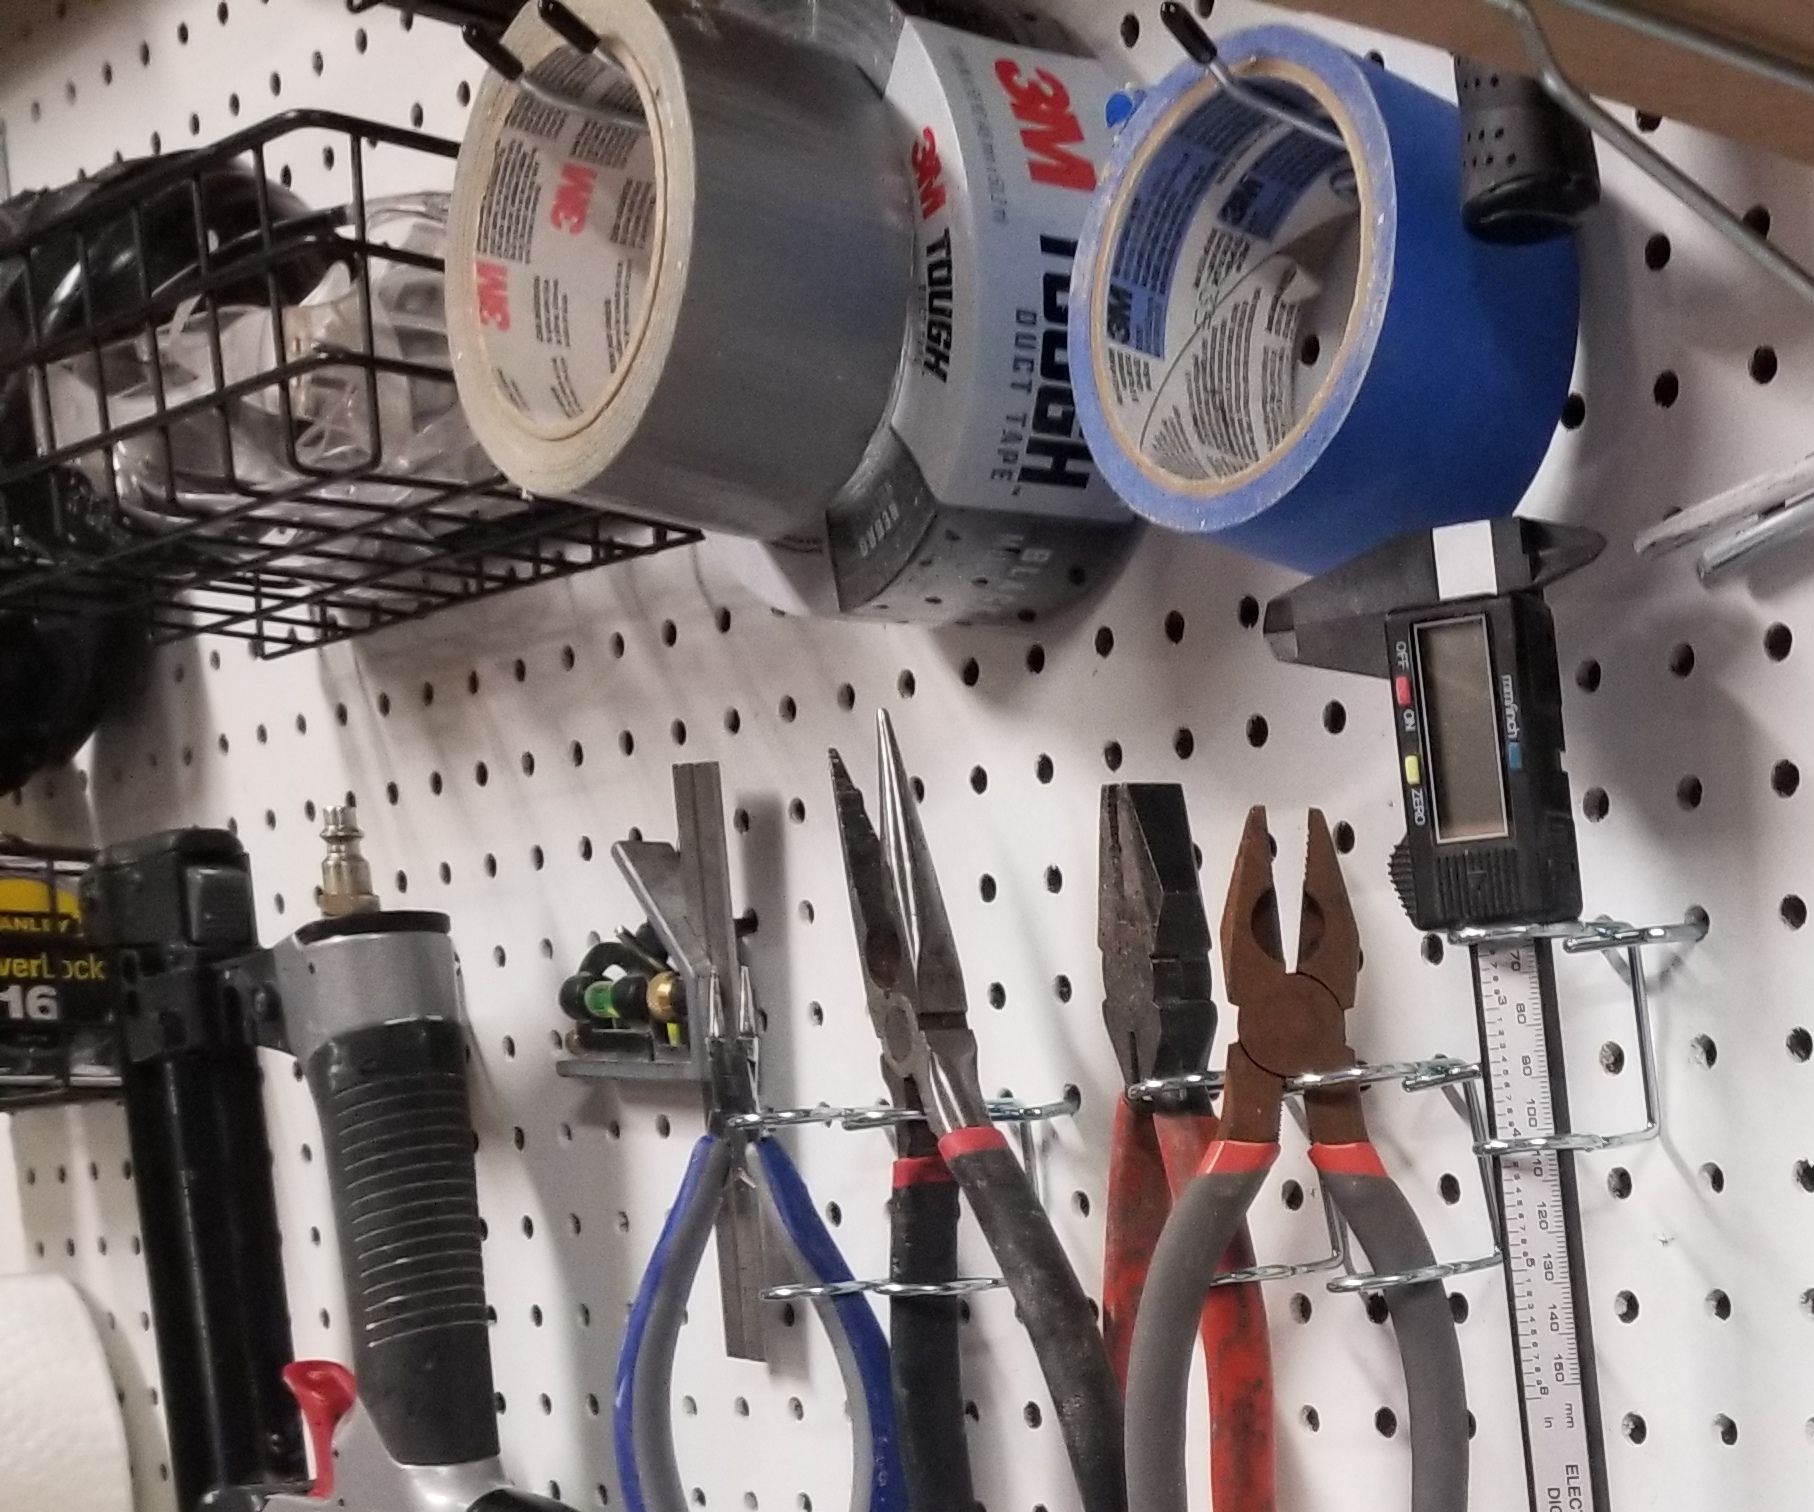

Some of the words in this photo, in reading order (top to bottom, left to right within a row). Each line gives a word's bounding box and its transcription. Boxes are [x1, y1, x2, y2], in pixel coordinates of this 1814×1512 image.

[994, 58, 1096, 193] 3M
[911, 127, 948, 220] 3M
[550, 162, 600, 236] 3M
[475, 261, 511, 332] 3M
[922, 227, 954, 382] TOUGH
[1010, 309, 1038, 395] DUCT
[990, 413, 1027, 482] TAPE
[1395, 641, 1408, 668] OFF
[1403, 709, 1416, 732] ON
[1411, 788, 1425, 826] ZERO
[0, 985, 58, 1020] 16
[1526, 1098, 1538, 1128] 100
[1537, 1201, 1548, 1232] 120
[1543, 1253, 1555, 1282] 130
[1548, 1304, 1560, 1332] 140
[1565, 1402, 1575, 1429] mm
